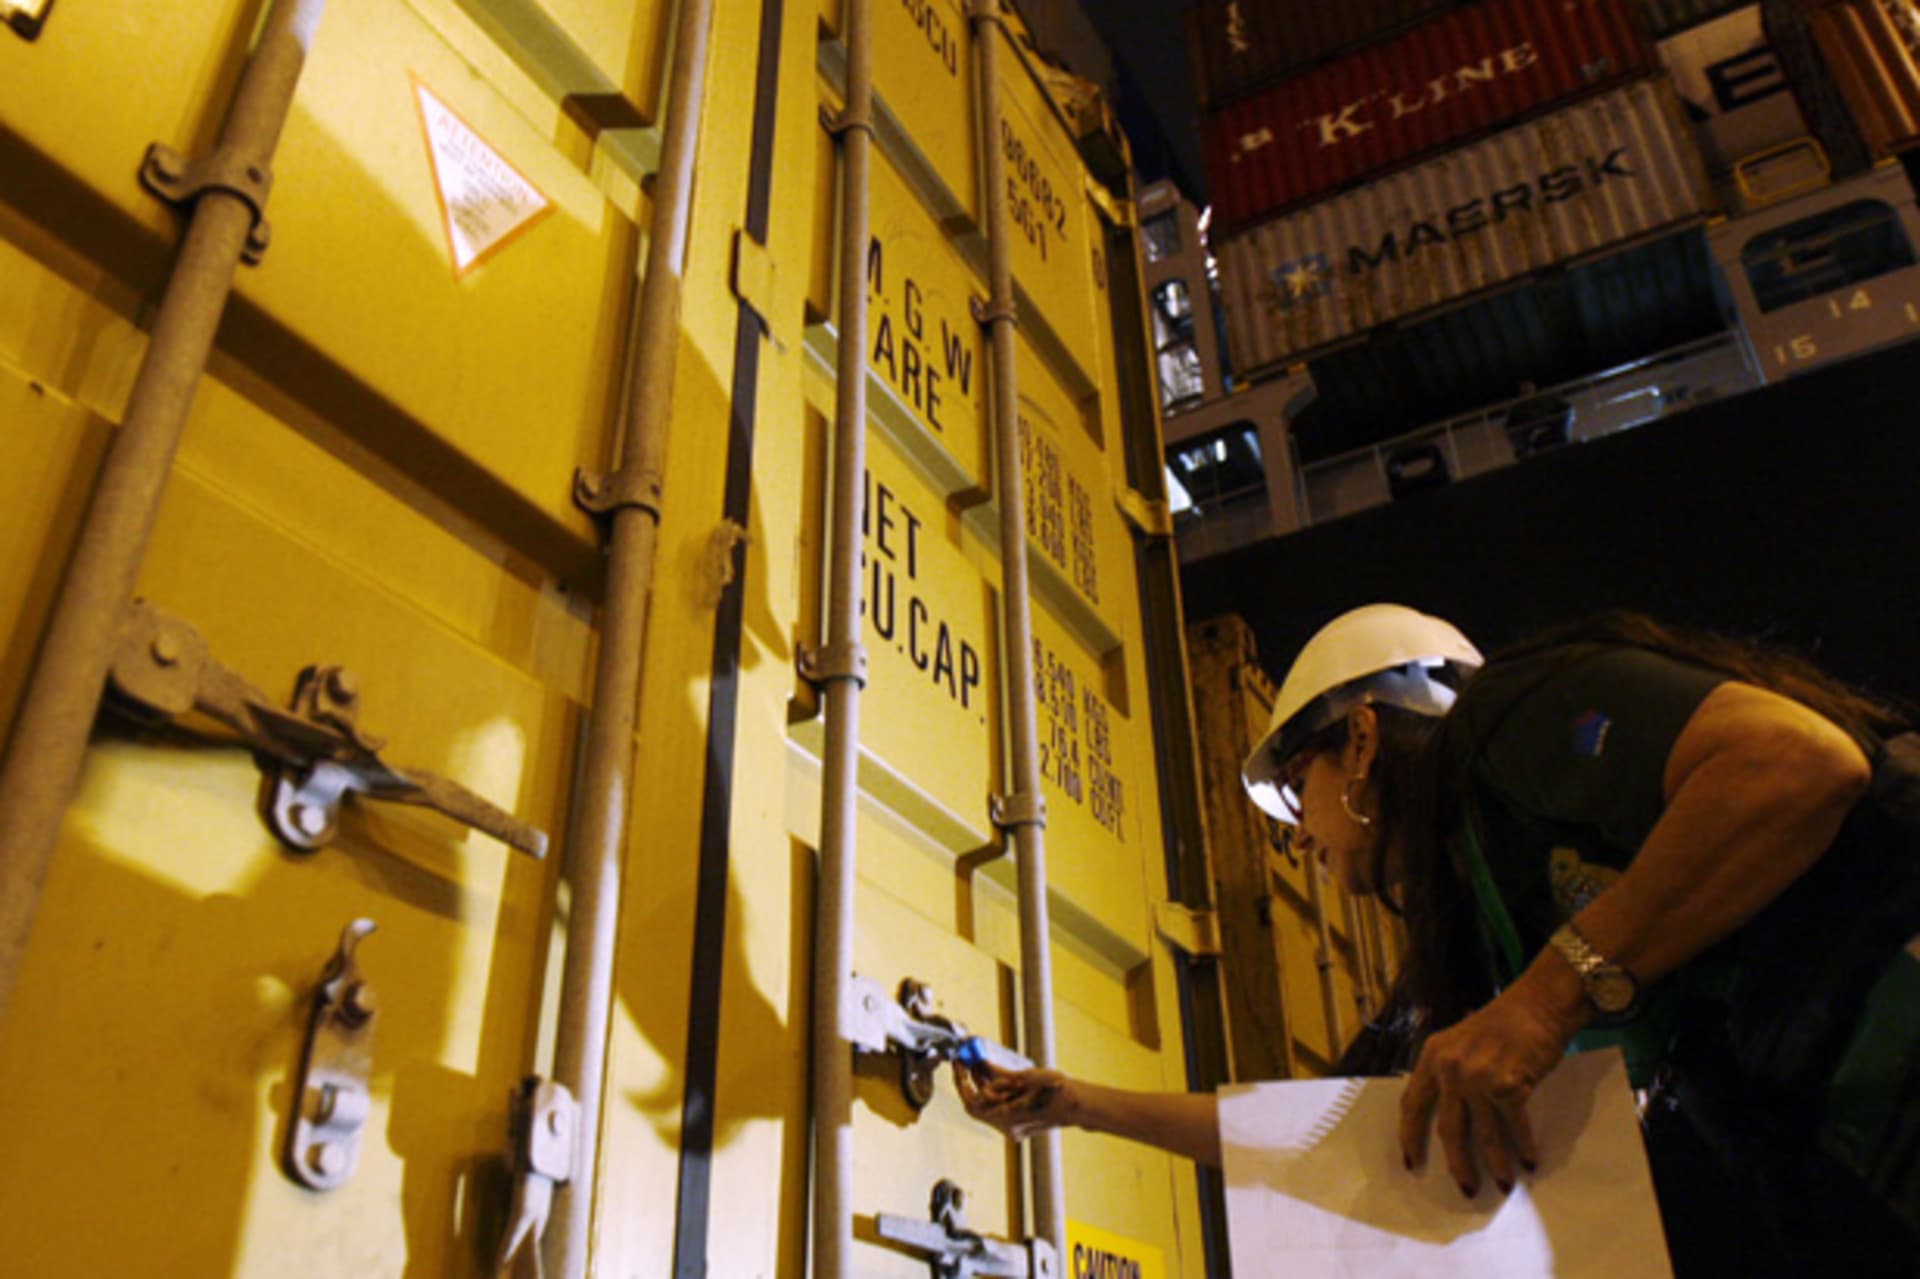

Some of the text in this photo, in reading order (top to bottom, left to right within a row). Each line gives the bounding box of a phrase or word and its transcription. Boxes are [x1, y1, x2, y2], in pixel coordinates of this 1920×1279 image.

[1393, 42, 1540, 121] LINE
[1347, 146, 1636, 275] MAERSK
[1774, 335, 1817, 365] 15
[1829, 289, 1872, 319] 14
[868, 298, 943, 433] ARE
[862, 469, 922, 581] ET
[860, 552, 984, 725] U.CAP.
